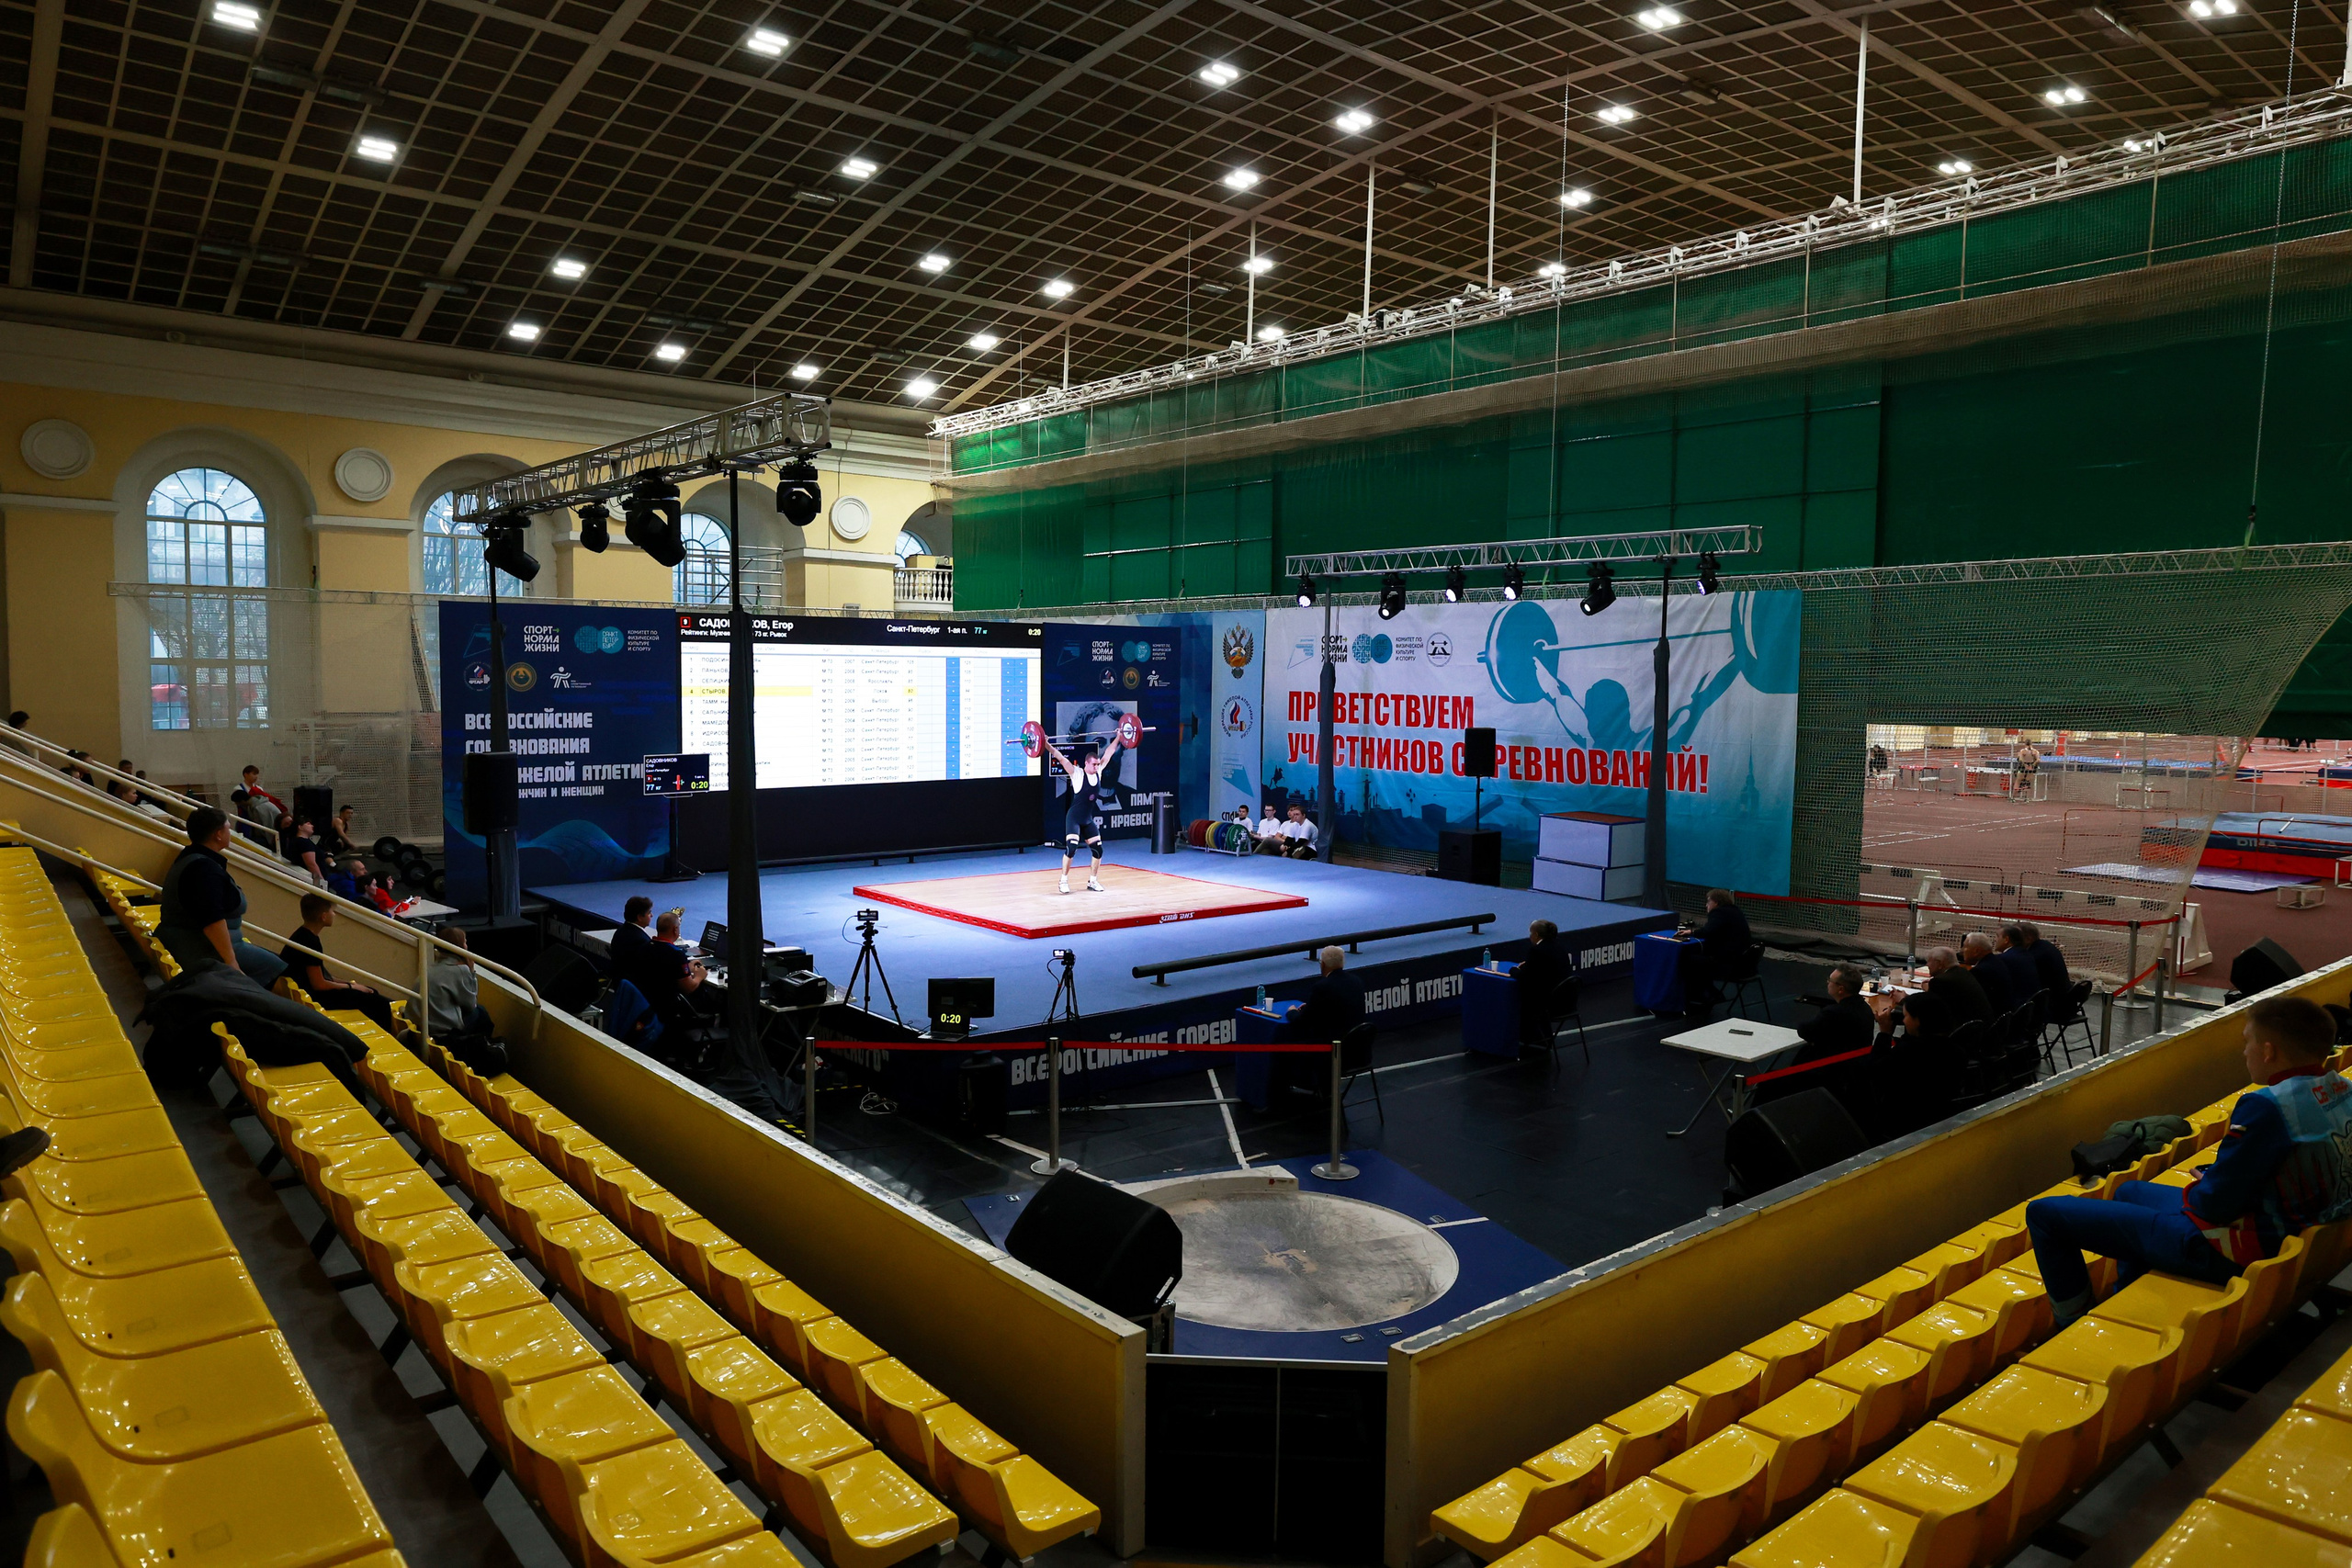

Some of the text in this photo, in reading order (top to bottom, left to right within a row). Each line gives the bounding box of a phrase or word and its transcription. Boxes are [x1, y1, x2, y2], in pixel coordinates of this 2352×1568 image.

[524, 626, 553, 634] СПОРТ
[772, 620, 794, 632] Егор
[887, 625, 941, 634] Санкт-Петербург
[974, 626, 982, 635] 77
[524, 635, 560, 643] НОРМА
[1321, 636, 1342, 644] СОРТ
[525, 644, 560, 652] ЖИЗНИ
[1224, 695, 1240, 707] ТЯЖЕЛОЙ
[1241, 697, 1253, 720] АТЛЕТИКИ
[465, 708, 594, 729] ВСЕОССИЙСКИЕ
[518, 761, 643, 783] ЖЕЛОЙ АТЛЕТИ
[1453, 742, 1709, 794] СРЕВНОВАНЙ!
[518, 785, 605, 798] ЖЧИН И ЖЕНЩИН
[1111, 812, 1152, 828] КРАЕВСК
[941, 1013, 961, 1023] 0:20
